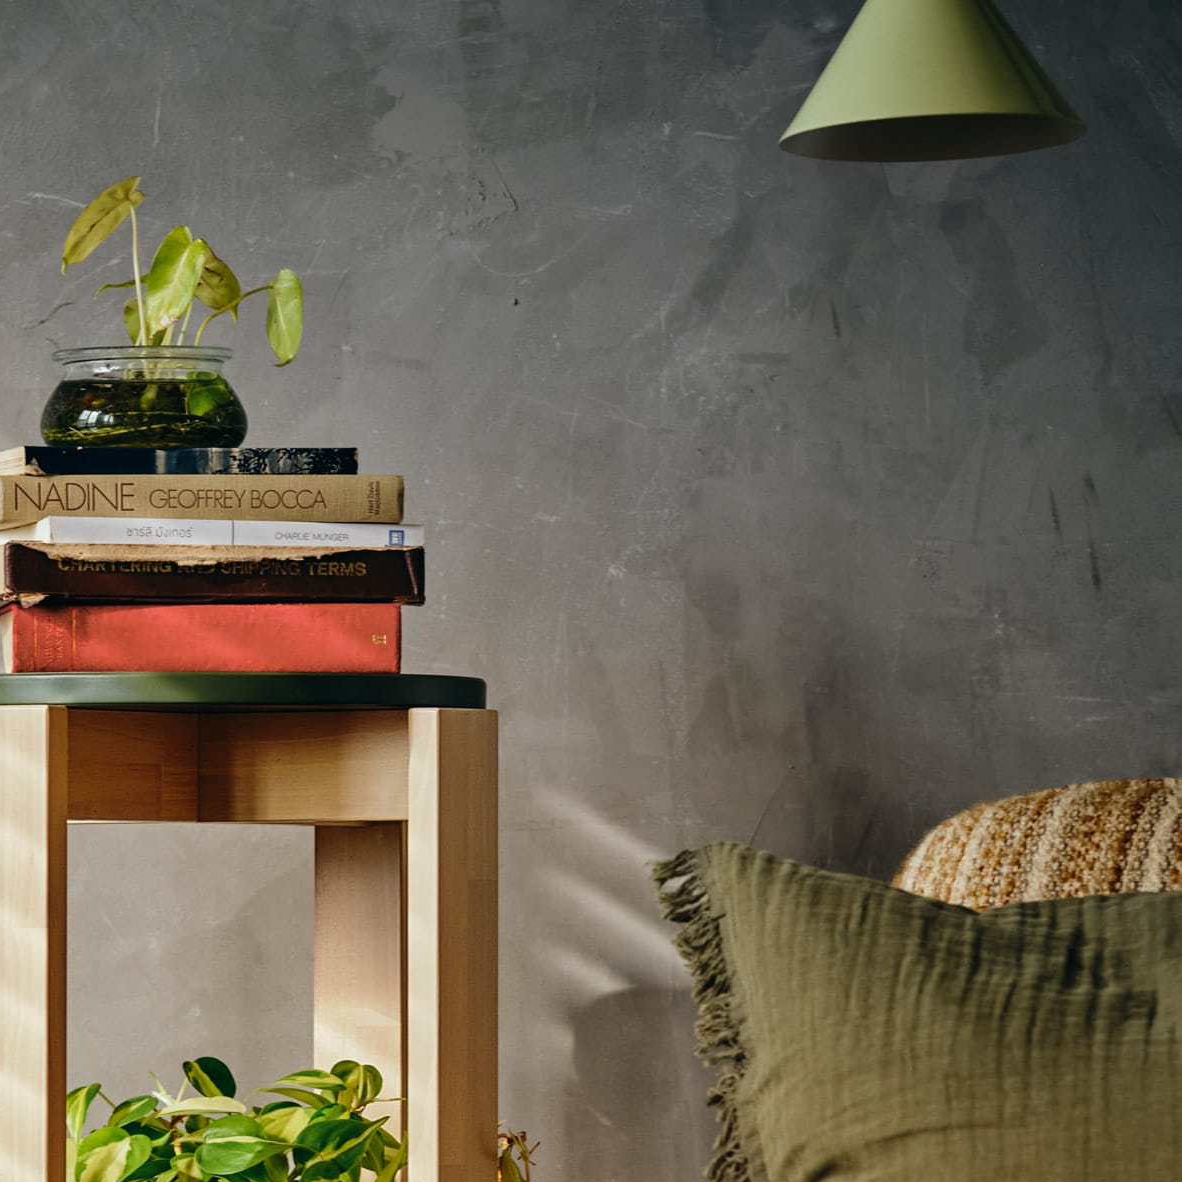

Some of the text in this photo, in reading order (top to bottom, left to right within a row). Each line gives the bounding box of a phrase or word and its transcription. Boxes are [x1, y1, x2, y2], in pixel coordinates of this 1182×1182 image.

[14, 482, 135, 512] NADINE
[149, 489, 327, 509] GEOFFREY BOCCA
[312, 533, 349, 541] MUNGER
[220, 560, 301, 576] SHIPPING
[306, 561, 367, 577] TERMS
